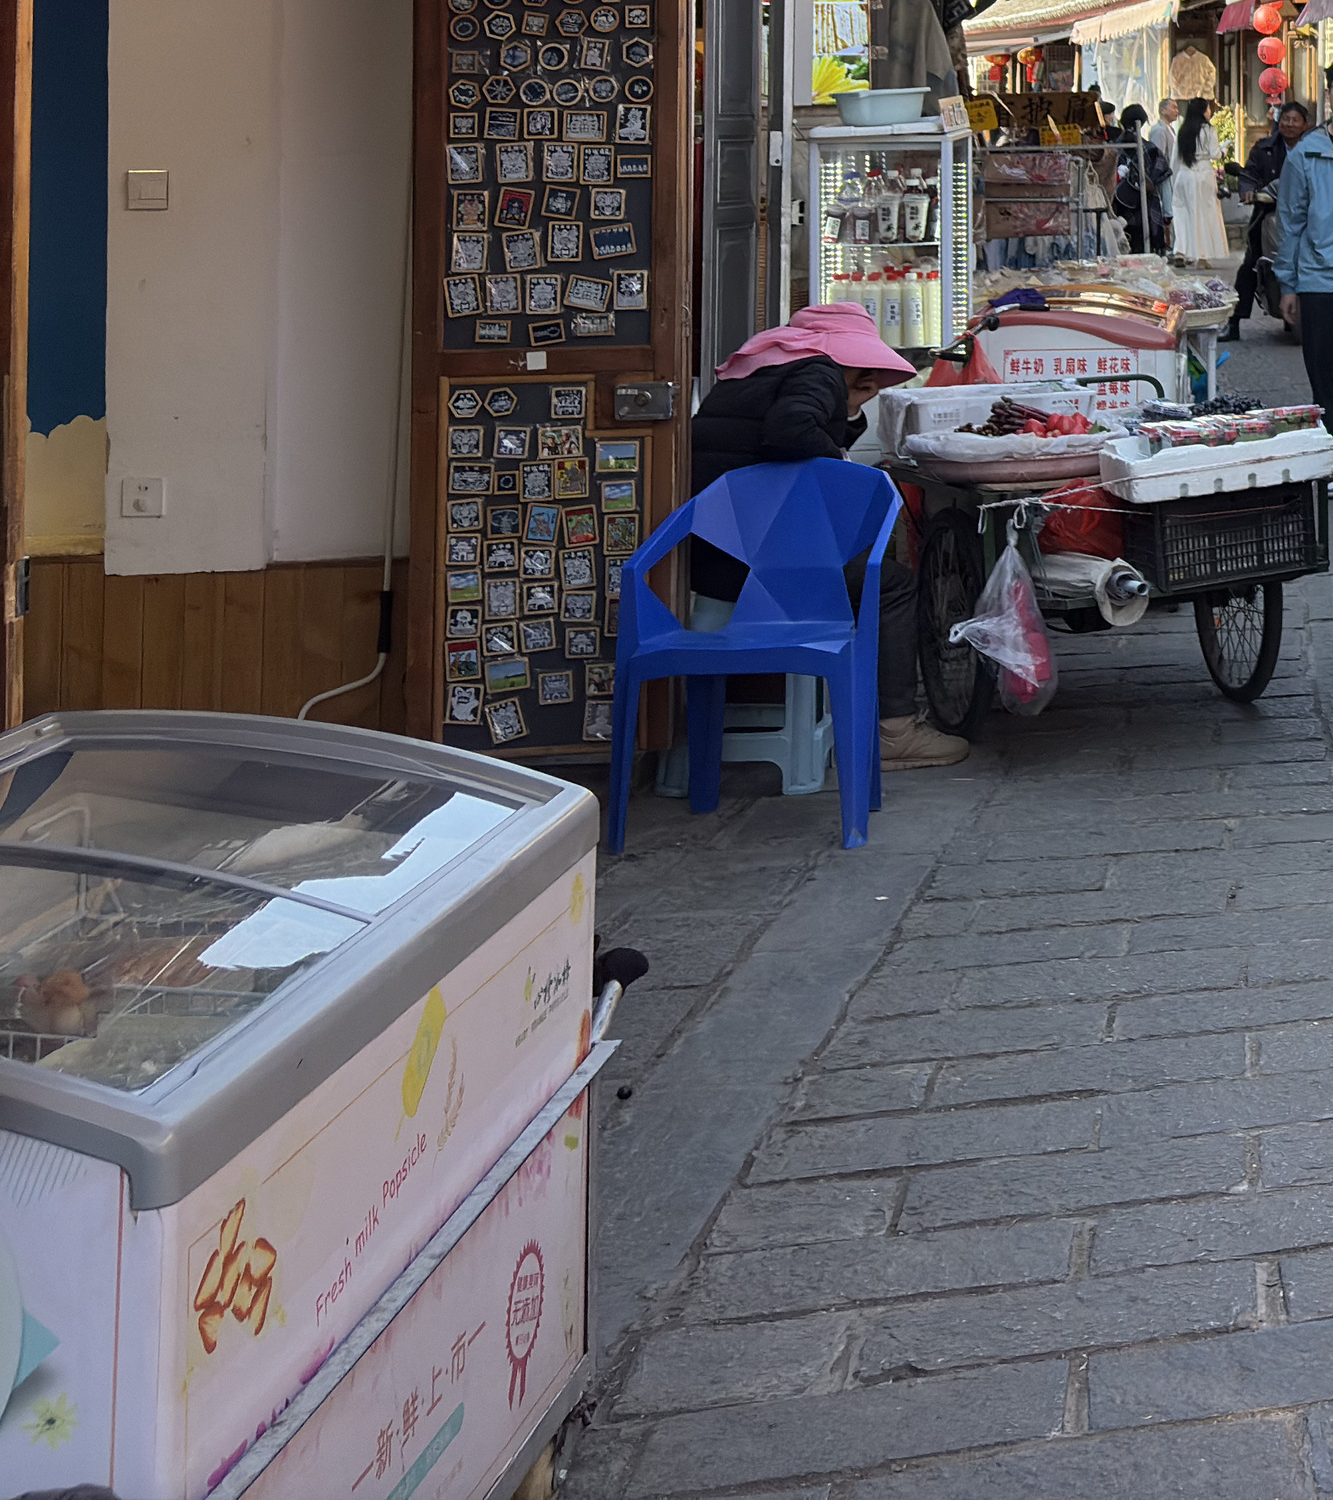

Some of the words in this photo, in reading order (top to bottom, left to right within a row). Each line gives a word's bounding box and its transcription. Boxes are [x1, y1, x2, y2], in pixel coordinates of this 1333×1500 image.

[1010, 358, 1044, 376] 鲜牛奶
[1053, 357, 1088, 375] 乳扇味
[1097, 356, 1131, 374] 鲜花味
[315, 1256, 352, 1327] Fresh
[355, 1204, 380, 1257] milk
[382, 1132, 428, 1208] Popsicle
